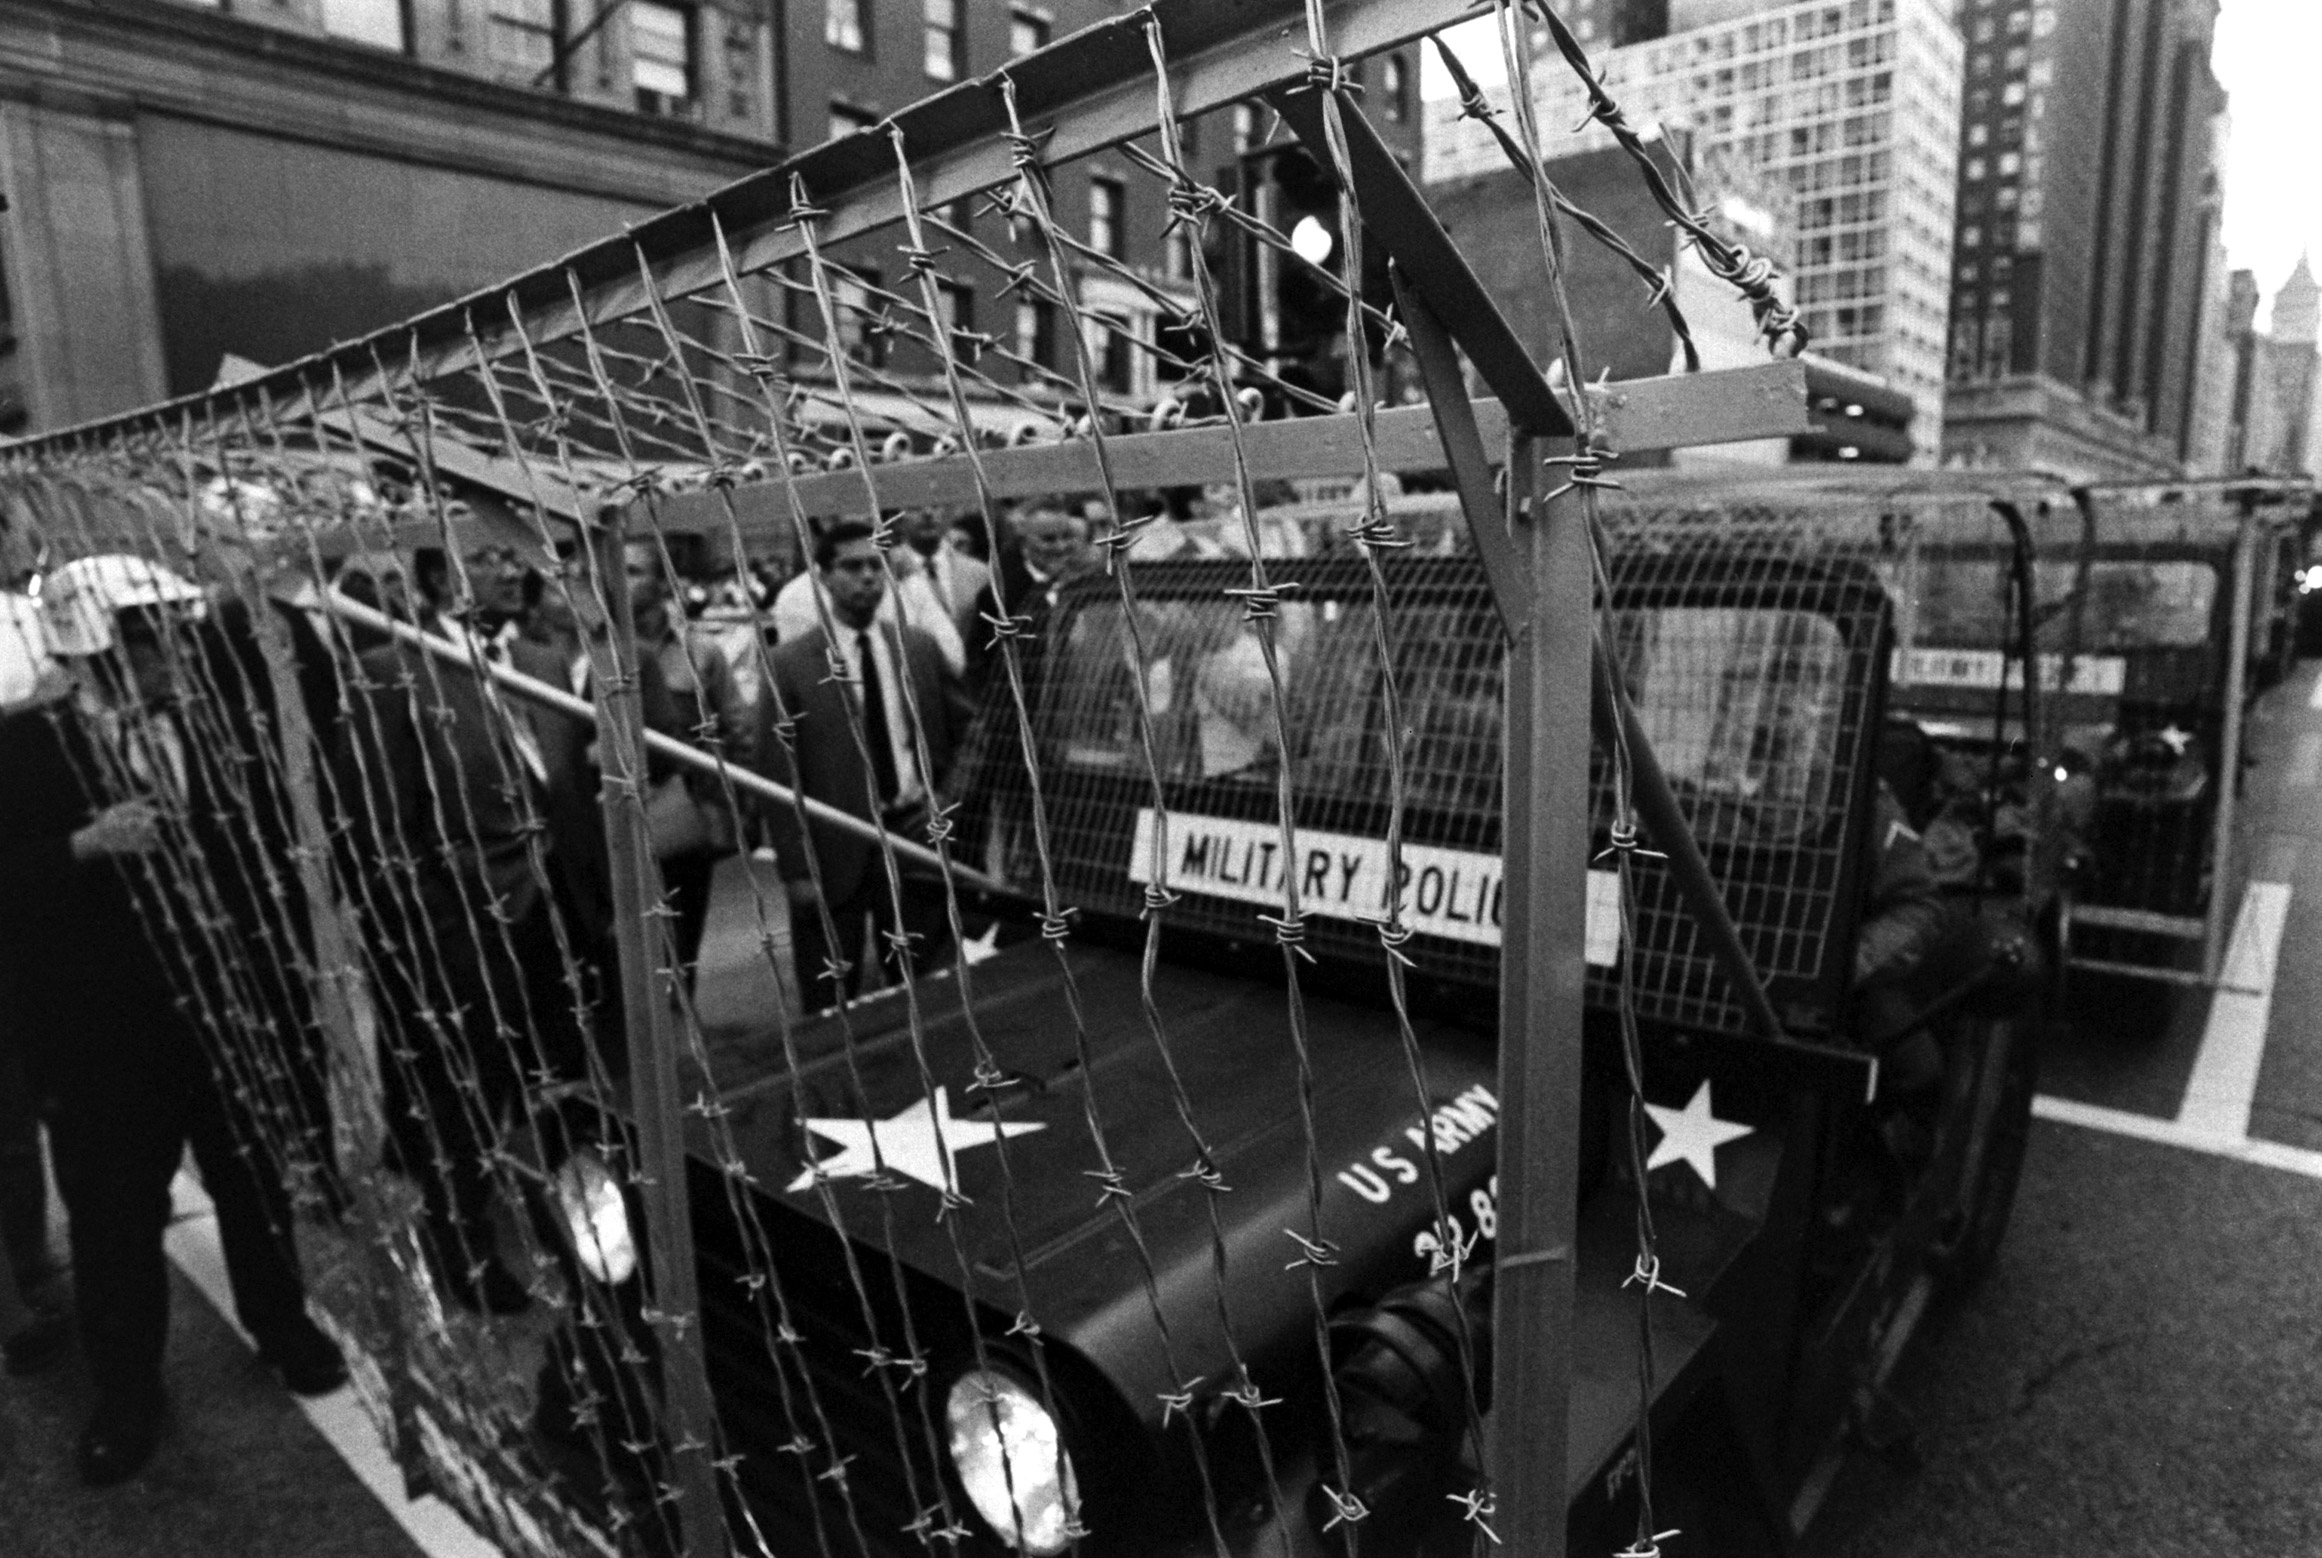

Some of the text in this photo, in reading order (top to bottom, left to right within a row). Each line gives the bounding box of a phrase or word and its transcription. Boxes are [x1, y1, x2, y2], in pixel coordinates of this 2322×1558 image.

[1180, 829, 1503, 927] MILITRY POLI
[1337, 1146, 1419, 1203] US
